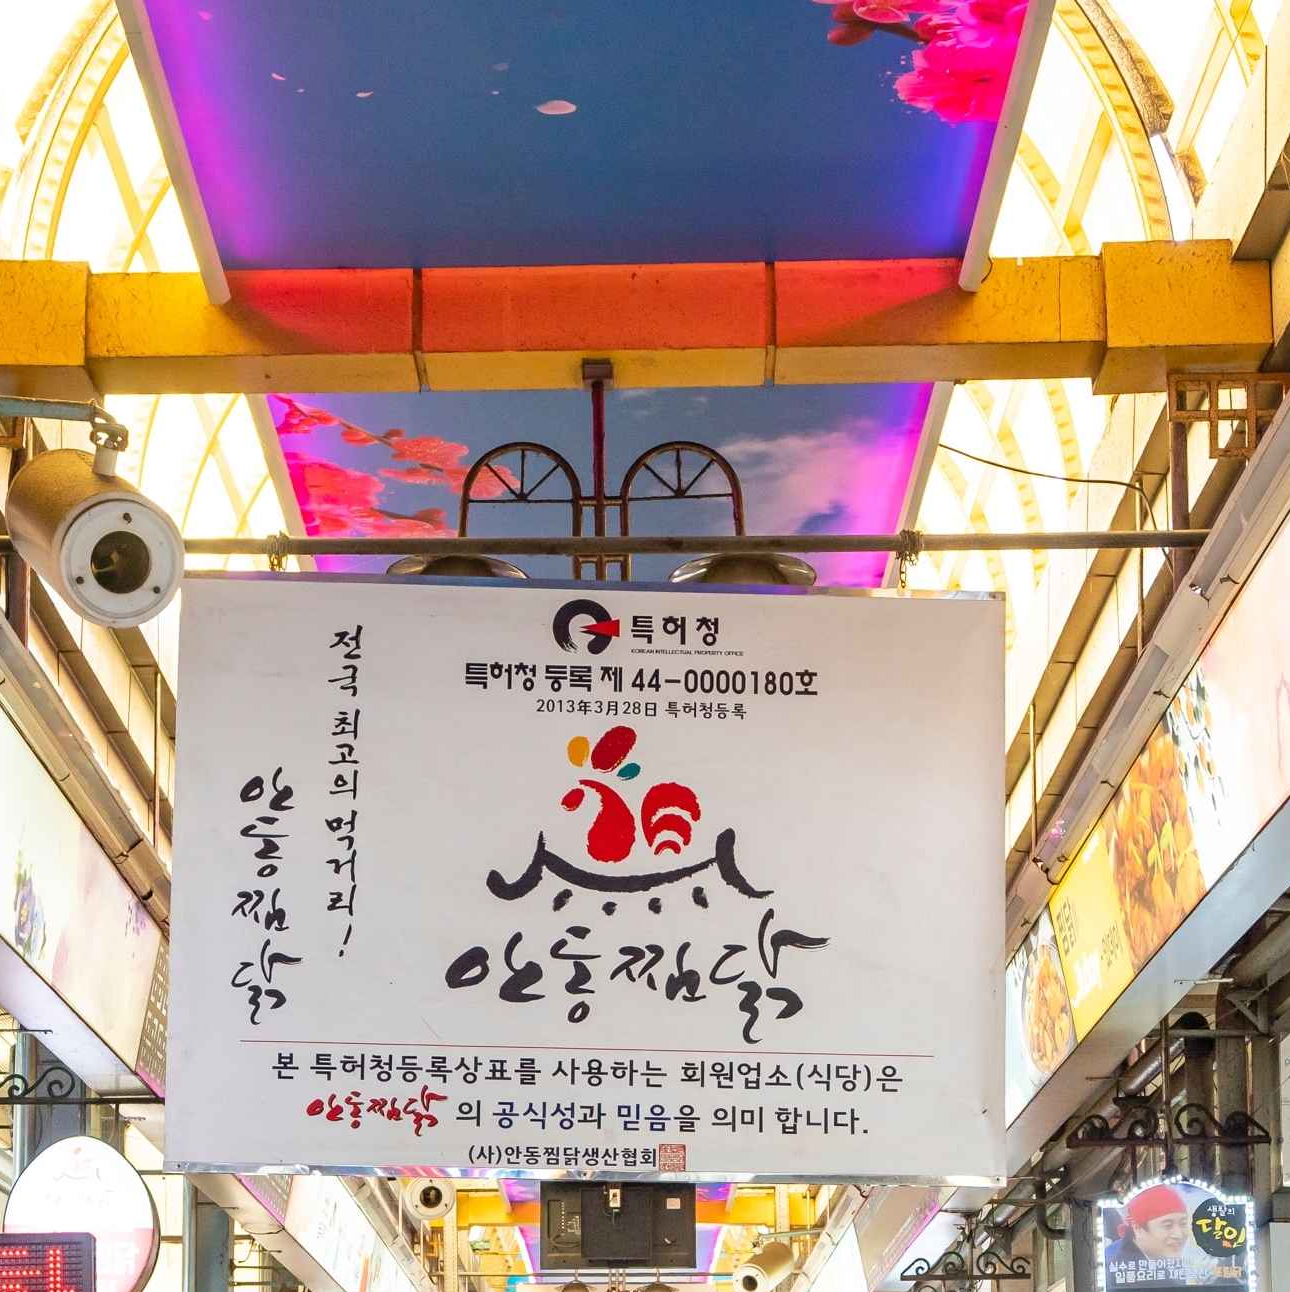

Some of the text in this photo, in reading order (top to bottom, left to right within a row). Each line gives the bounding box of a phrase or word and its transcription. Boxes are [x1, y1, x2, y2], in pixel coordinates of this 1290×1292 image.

[631, 615, 720, 647] 특허청
[329, 625, 363, 699] 전국
[465, 662, 819, 697] 특허청 등록 제 44-0000180호
[665, 700, 747, 720] 특허청등록
[328, 711, 362, 800] 최고의
[231, 767, 302, 1026] 안동찜닭
[445, 907, 830, 1045] 안동찜닭
[272, 1052, 904, 1094] 본 특허청등록상표를 사용하는 회원업소(식당)은
[306, 1084, 870, 1138] 안동찜닭 의 공식성과 믿음을 의미 합니다.
[467, 1143, 658, 1169] (사)안동찜닭생산협회
